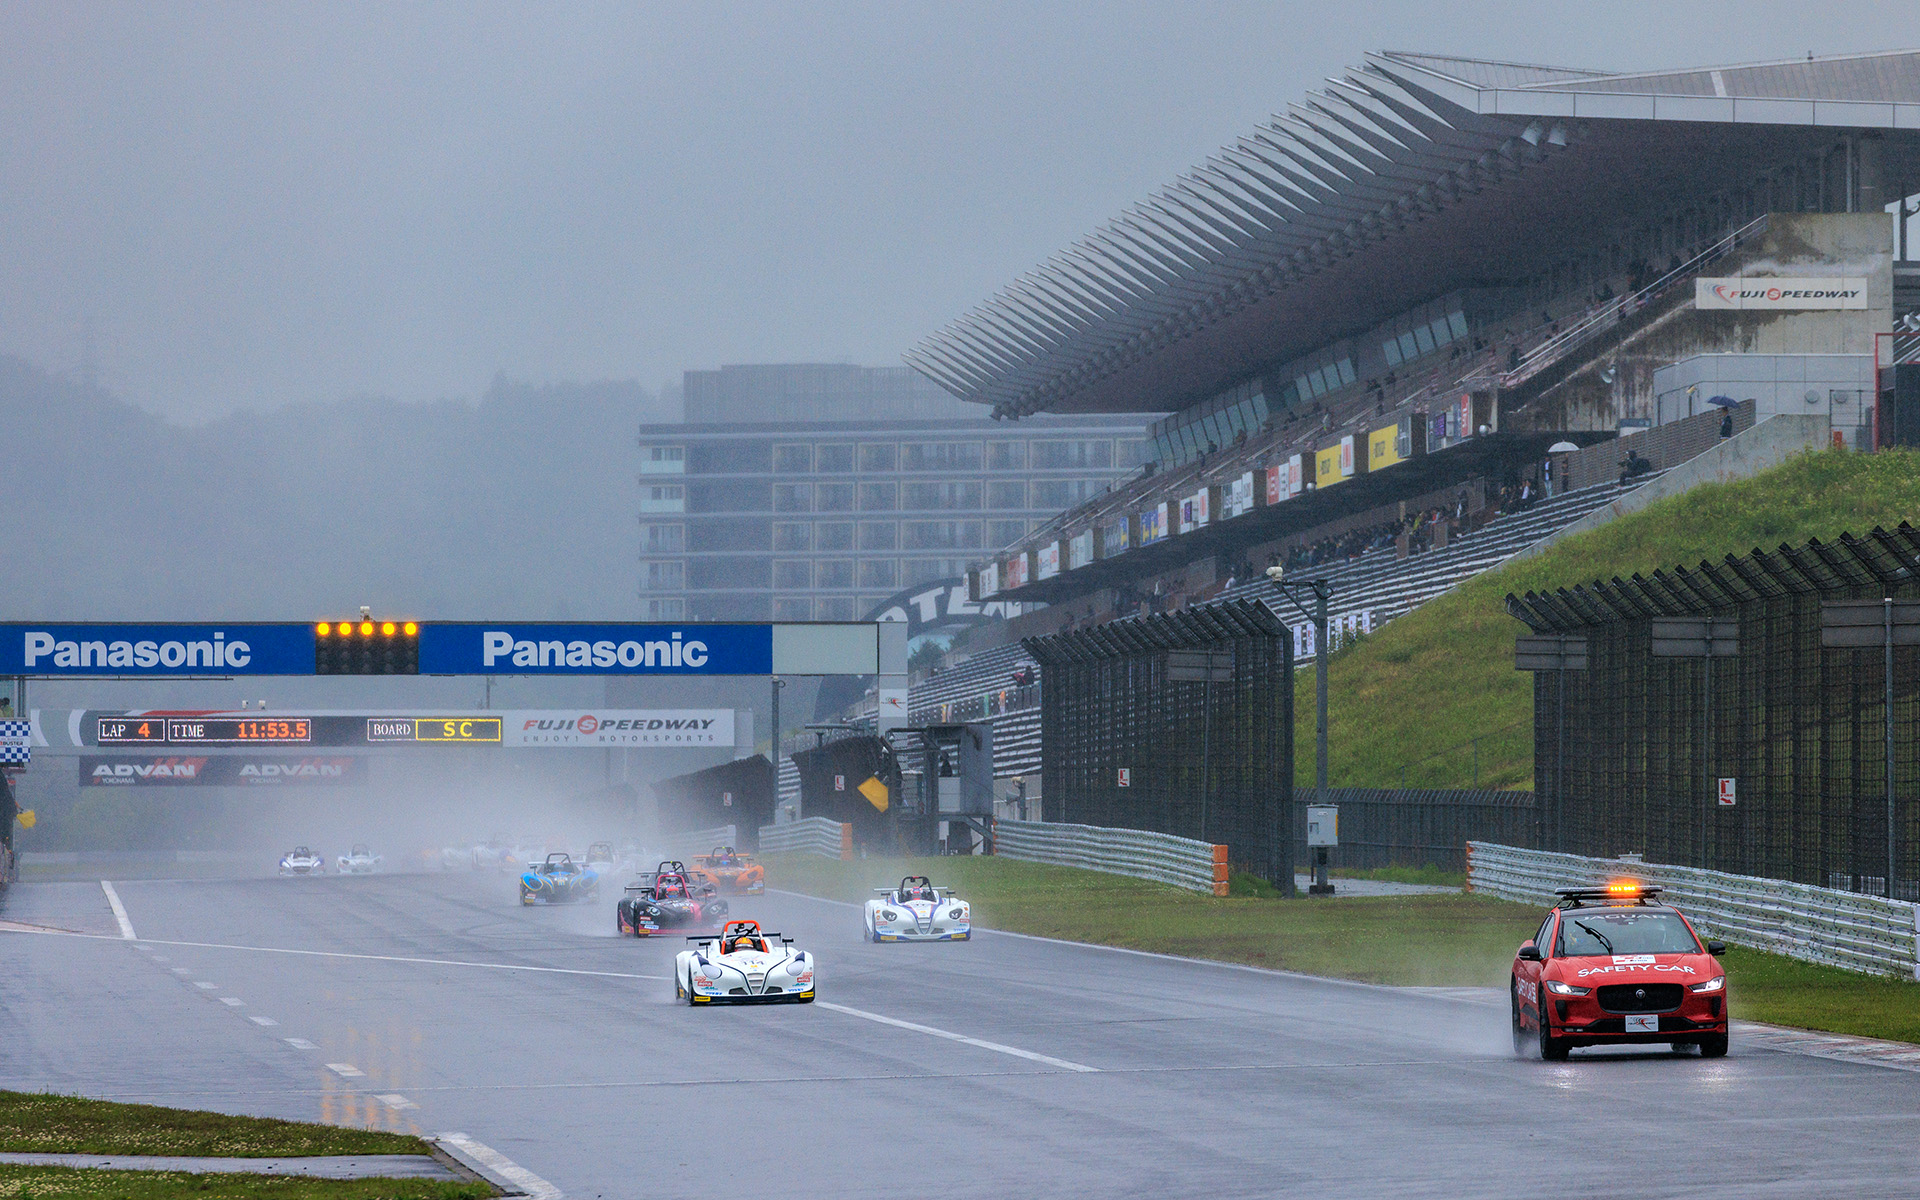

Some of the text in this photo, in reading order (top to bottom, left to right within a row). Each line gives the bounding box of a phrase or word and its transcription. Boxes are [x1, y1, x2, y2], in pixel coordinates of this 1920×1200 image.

[1729, 287, 1860, 301] FUJI SPEEDWAY
[24, 631, 251, 668] Panasonic
[483, 631, 708, 668] Panasonic
[101, 722, 151, 738] LAP 4
[172, 722, 307, 738] TIME 11:53.5
[373, 723, 411, 736] BOARD
[443, 722, 473, 738] SC
[523, 714, 715, 735] FUJI SPEEDWAY
[599, 734, 714, 743] MOTORSPORTS
[92, 764, 195, 777] ADVAN
[239, 764, 342, 777] ADVAN
[102, 777, 136, 785] YOKOHAMA
[1577, 964, 1697, 978] SAFETY CAR
